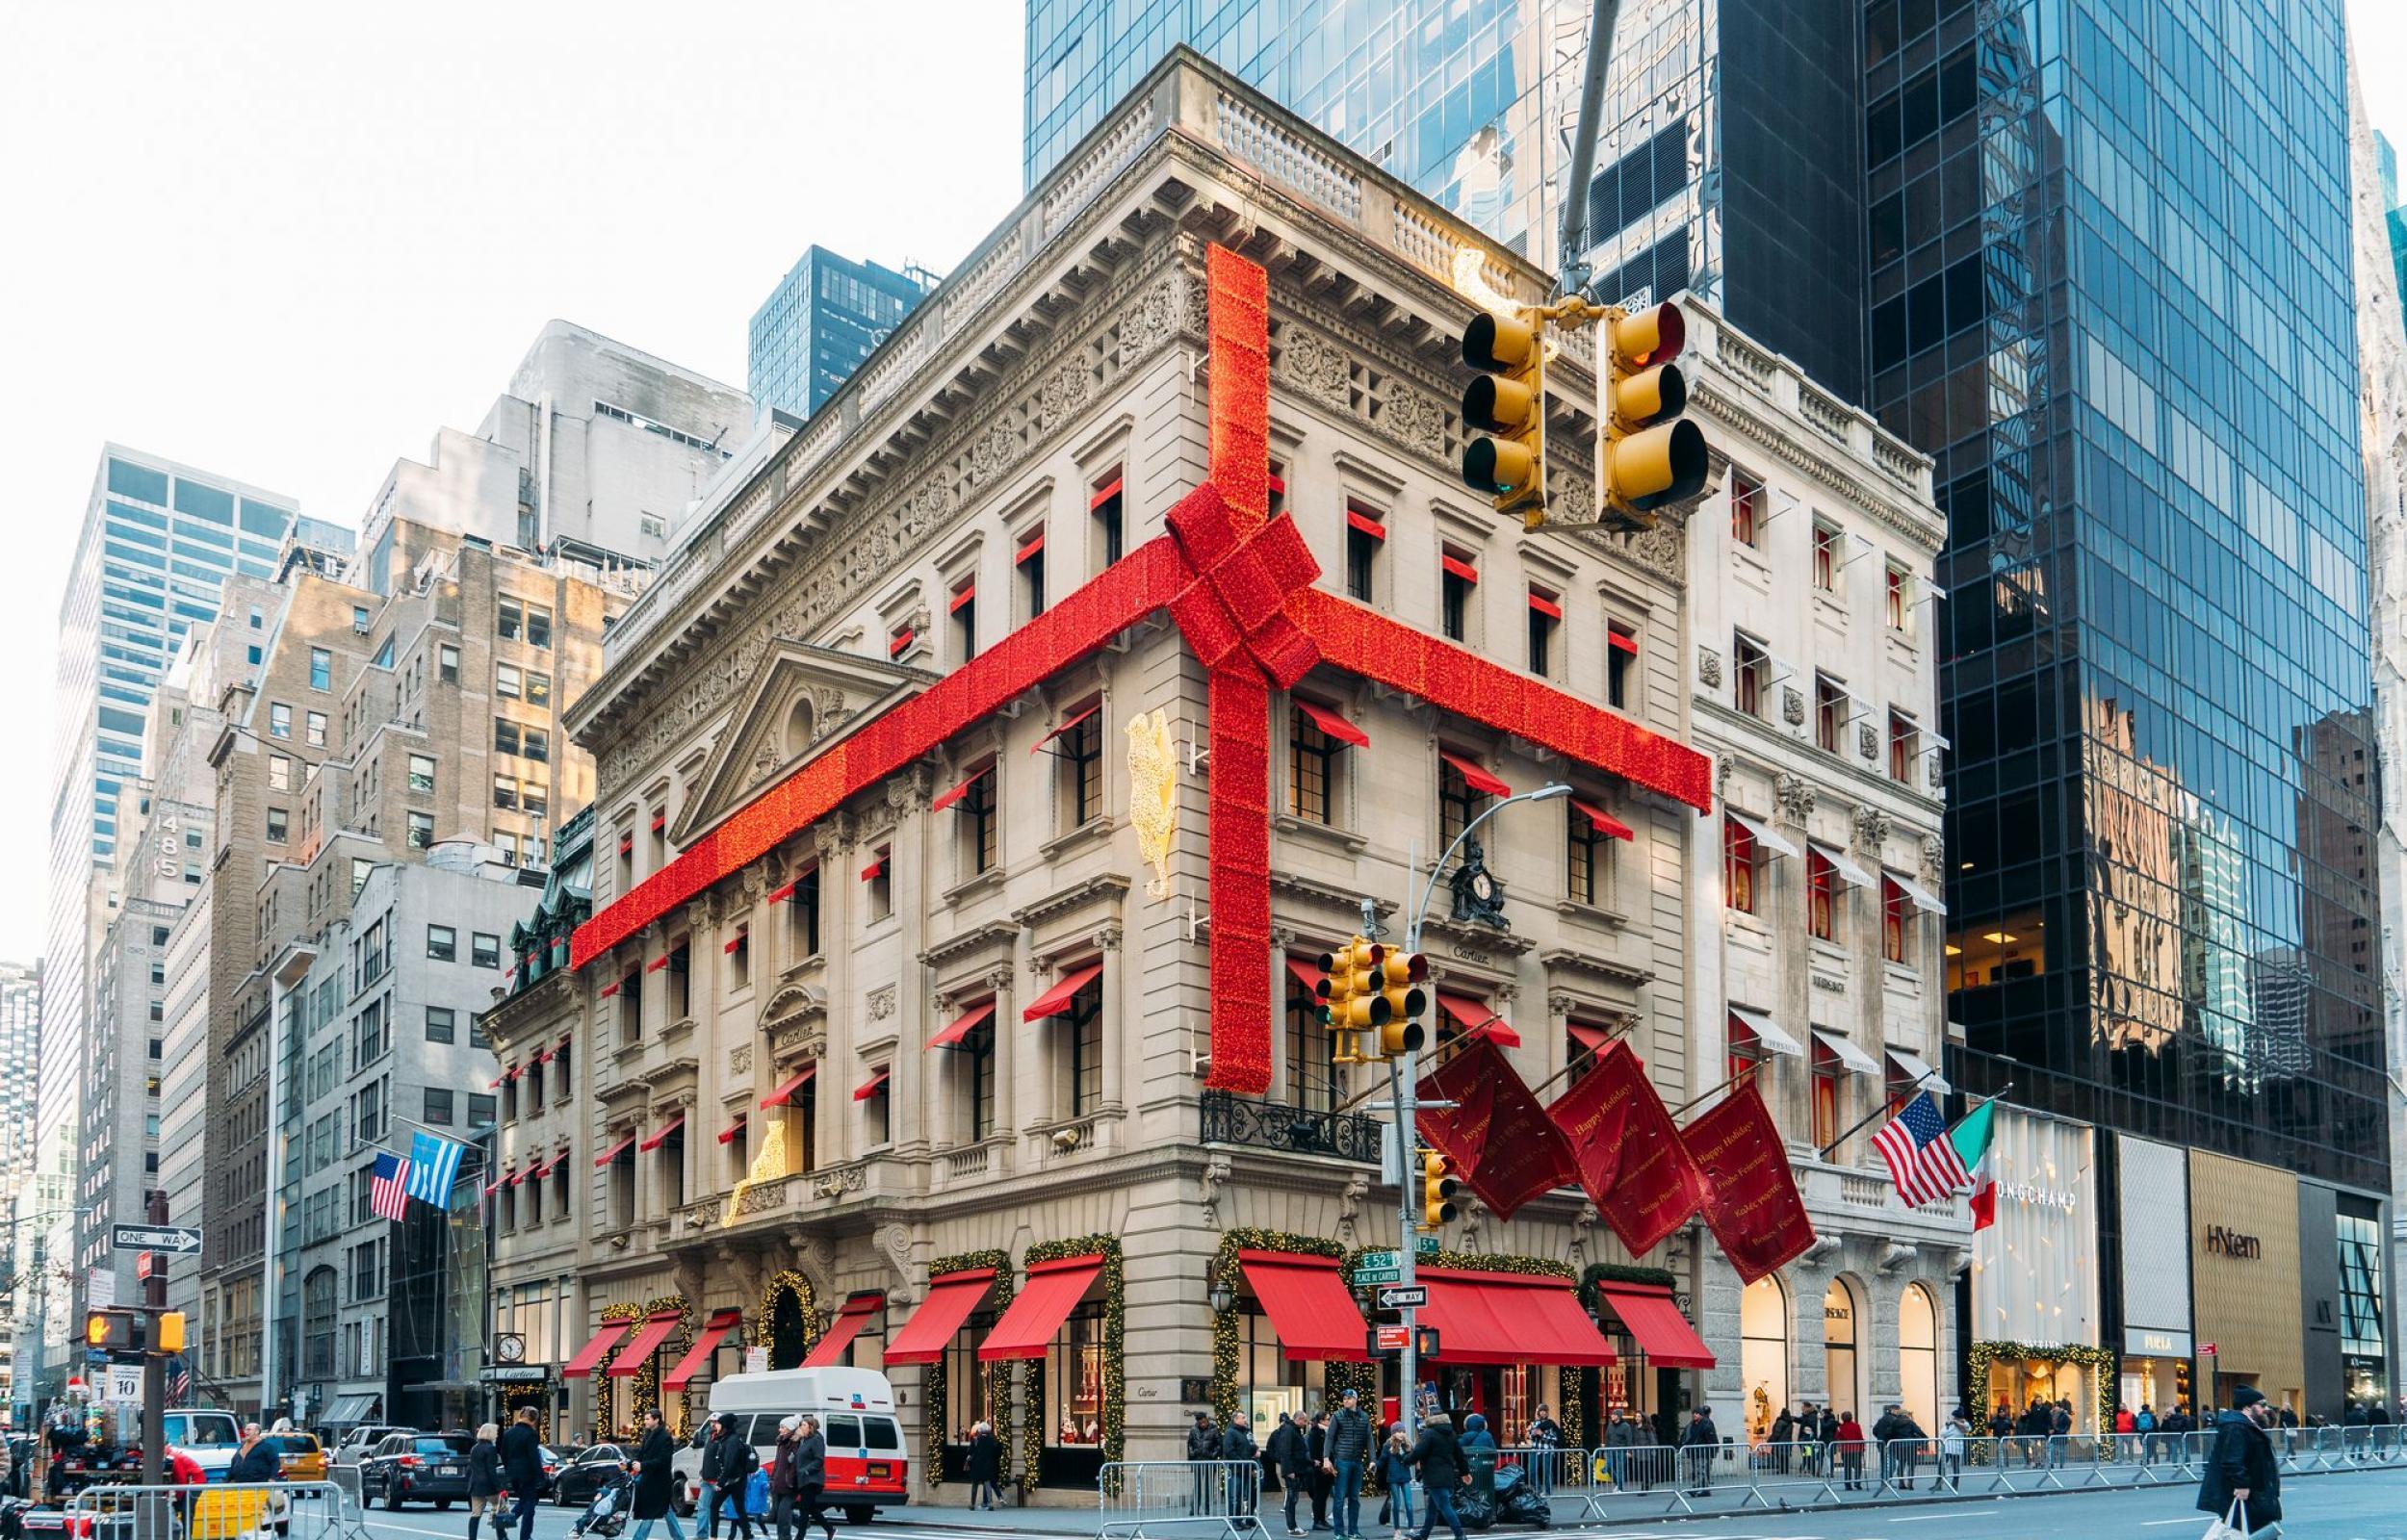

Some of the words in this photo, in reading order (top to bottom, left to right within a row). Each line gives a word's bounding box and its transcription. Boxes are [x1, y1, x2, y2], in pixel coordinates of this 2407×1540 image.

[1454, 946, 1489, 963] Cartier
[1436, 1096, 1464, 1119] Hay
[1573, 1114, 1602, 1137] Happy
[1600, 1083, 1633, 1115] Holidays
[1697, 1142, 1724, 1166] Happy
[1722, 1119, 1754, 1147] Holidays
[1996, 1180, 2076, 1209] ONGCHAMP
[120, 1232, 146, 1243] ONE
[162, 1235, 189, 1245] WAY
[1422, 1239, 1429, 1250] 5
[1364, 1256, 1371, 1268] E
[1373, 1255, 1386, 1267] 52
[1355, 1272, 1371, 1283] PLACE
[1378, 1270, 1399, 1281] CARTIER
[1385, 1294, 1399, 1302] ONE
[1405, 1293, 1420, 1301] WAY
[505, 1369, 535, 1377] Cartier
[116, 1380, 135, 1396] 10
